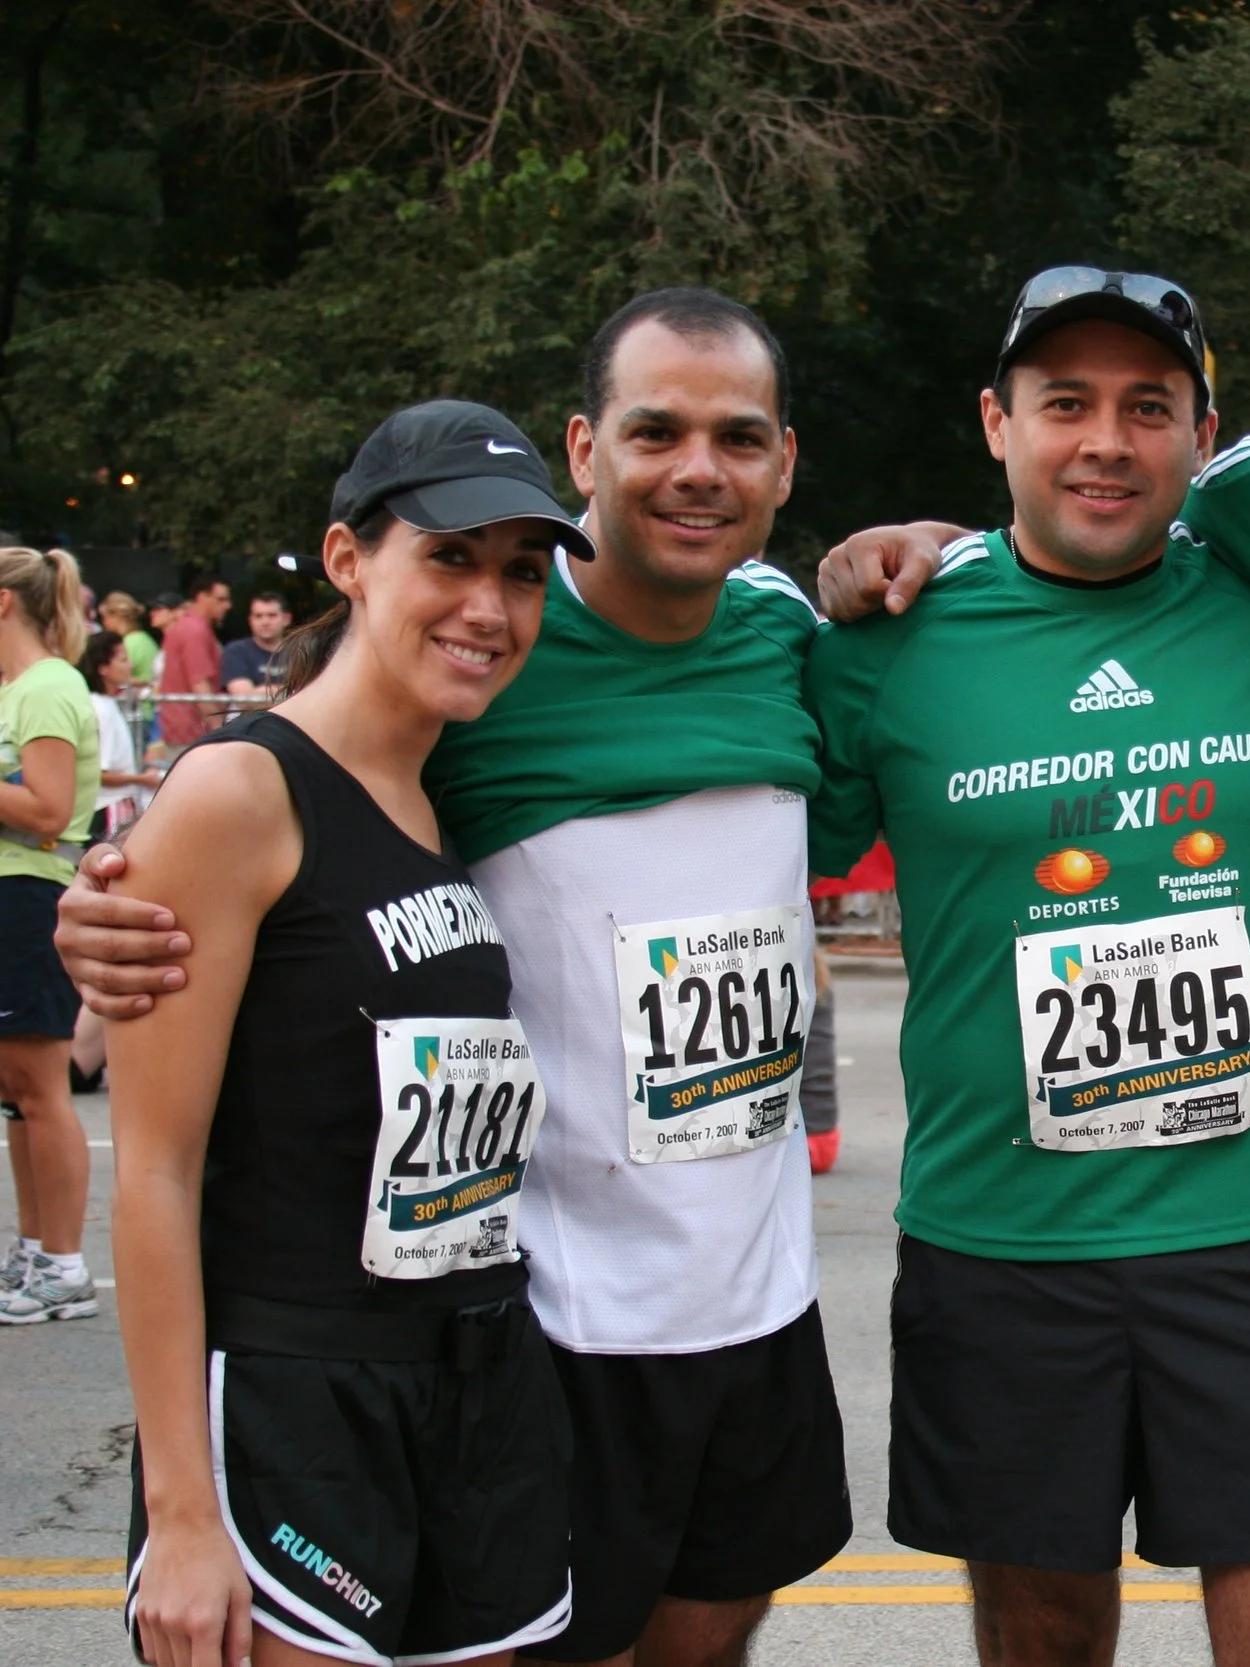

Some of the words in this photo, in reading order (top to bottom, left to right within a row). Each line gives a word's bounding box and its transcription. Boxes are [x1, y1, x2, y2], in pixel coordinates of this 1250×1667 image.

[1070, 688, 1154, 713] adidas
[947, 751, 1114, 803] CORREDOR
[1127, 740, 1190, 775] CON
[1049, 779, 1216, 839] MÉXICO
[1159, 868, 1239, 891] Fundación
[1169, 885, 1232, 903] Televisa
[1029, 897, 1119, 920] DEPORTES
[687, 931, 749, 956] LaSalle
[753, 925, 785, 947] Bank
[1092, 937, 1165, 964] LaSalle
[1171, 929, 1219, 953] Bank
[690, 963, 711, 975] ABN
[715, 958, 743, 971] AMRO
[1094, 968, 1120, 981] ABN
[1124, 964, 1159, 978] AMRO
[639, 962, 805, 1070] 12612
[1035, 964, 1250, 1074] 23495
[447, 1039, 497, 1060] LaSalle
[446, 1069, 465, 1080] ABN
[468, 1068, 490, 1080] AMRO
[671, 1083, 706, 1108] 30th
[712, 1050, 799, 1097] ANNIVERSARY
[1072, 1084, 1109, 1108] 30th
[390, 1082, 535, 1177] 21181
[657, 1130, 702, 1144] October
[705, 1129, 714, 1140] 7,
[717, 1124, 738, 1137] 2007
[1059, 1125, 1105, 1138] October
[1108, 1125, 1118, 1135] 7,
[1120, 1120, 1145, 1133] 2007
[1186, 1119, 1234, 1132] ANNIVERSARY
[414, 1196, 448, 1221] 30th
[452, 1171, 517, 1212] ANNIVERSARY
[394, 1245, 438, 1260] October
[440, 1244, 447, 1257] 7,
